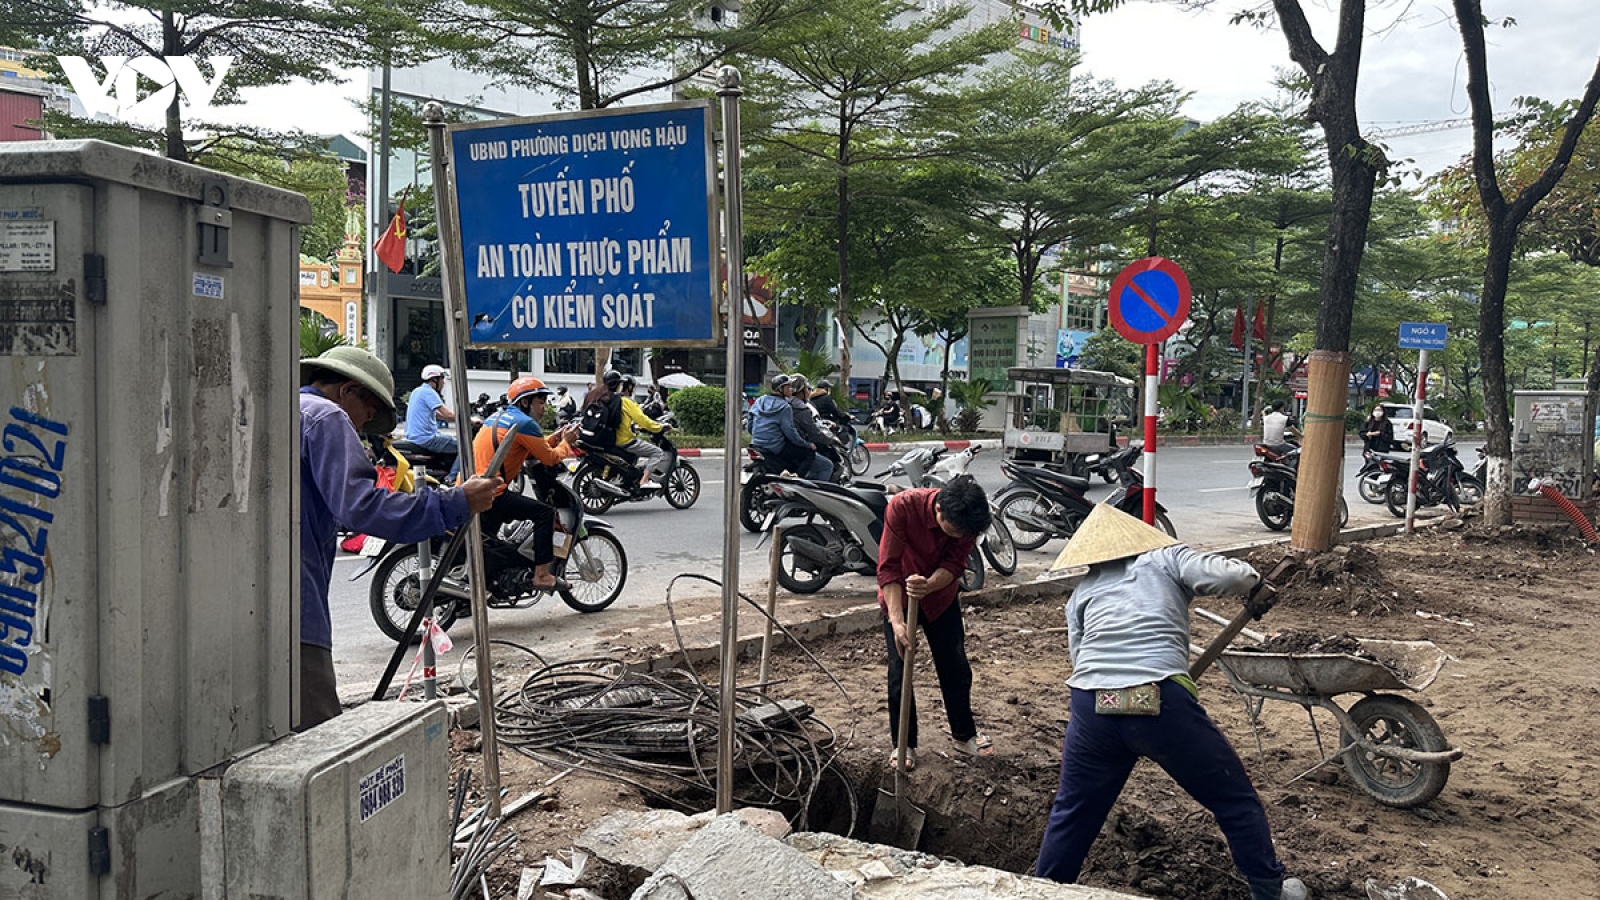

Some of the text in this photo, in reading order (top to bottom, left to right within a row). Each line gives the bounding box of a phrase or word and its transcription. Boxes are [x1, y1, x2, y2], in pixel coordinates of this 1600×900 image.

[469, 120, 688, 161] UBND PHƯỜNG DỊCH VỌNG HẬU
[518, 160, 636, 218] TUYẾN PHỐ
[477, 219, 692, 284] AN TOÀN THỰC PHẨM
[511, 279, 655, 329] CÓ KIỂM SOÁT
